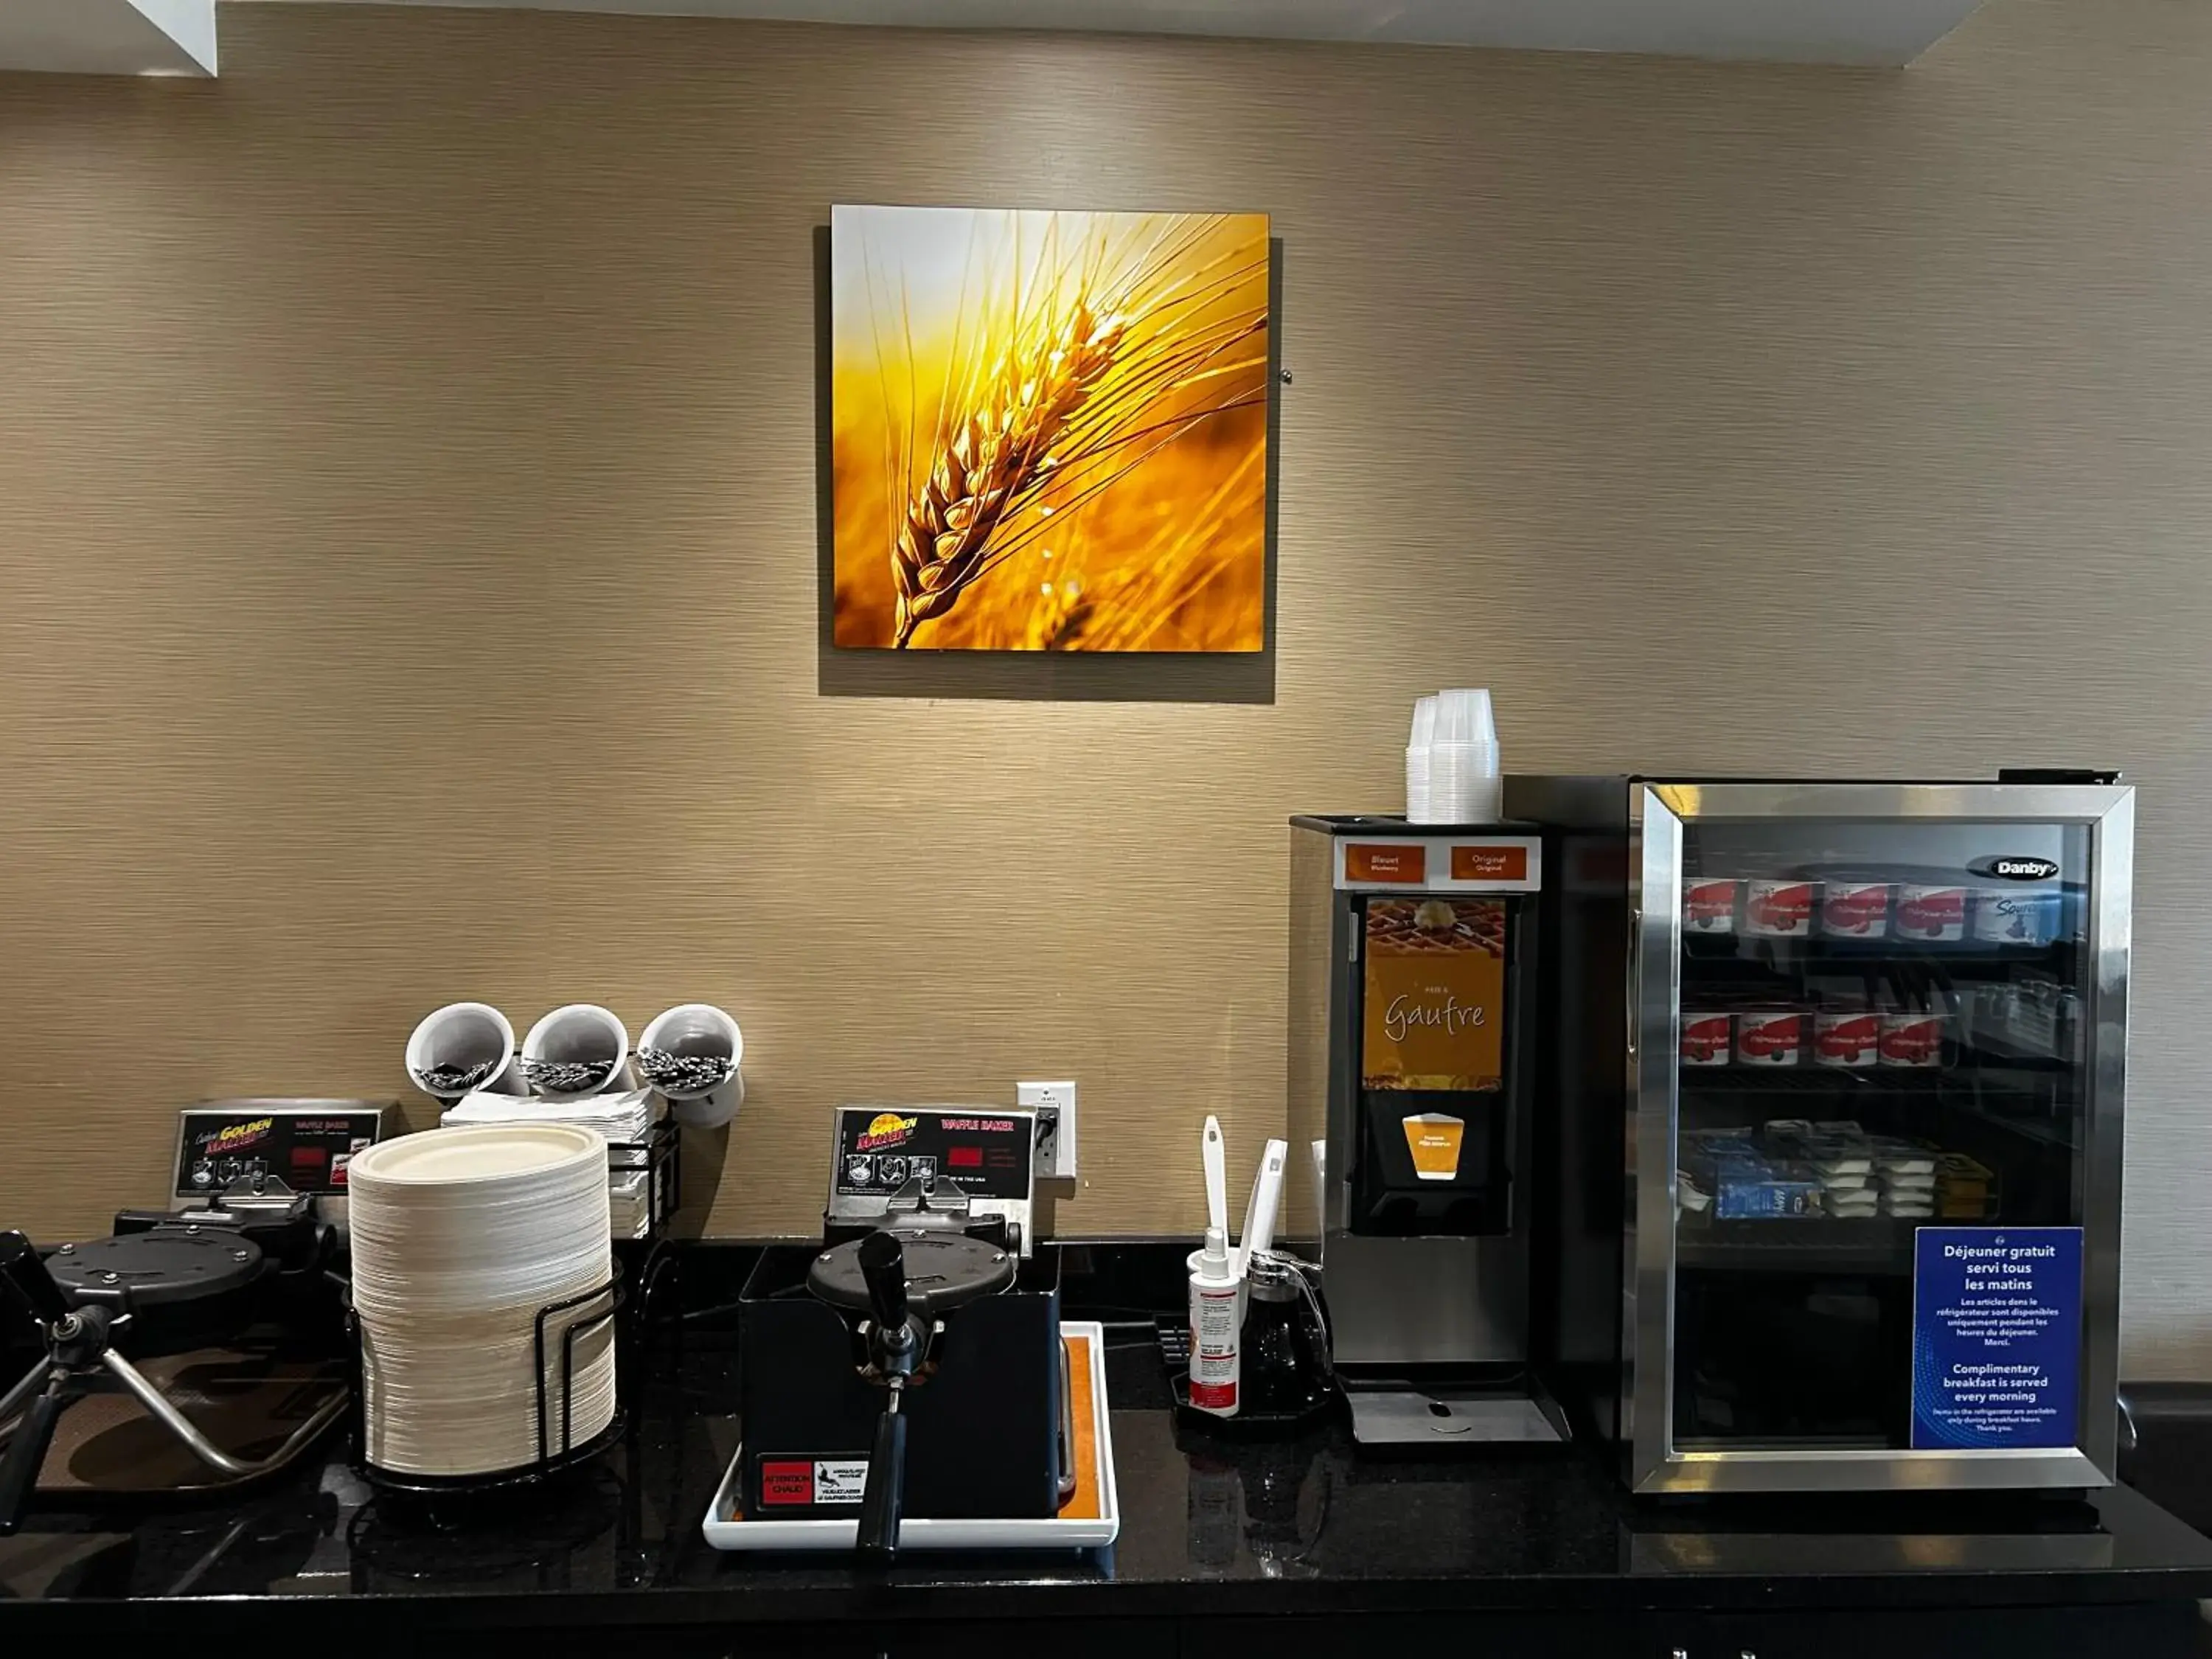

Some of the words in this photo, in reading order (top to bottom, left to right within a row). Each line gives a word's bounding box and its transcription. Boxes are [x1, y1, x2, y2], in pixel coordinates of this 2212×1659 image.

[1472, 855, 1506, 866] Original
[1997, 861, 2048, 877] Danby
[1385, 995, 1485, 1041] Gaufre
[220, 1118, 274, 1140] GOLDEN
[940, 1119, 979, 1130] WAFFLE
[981, 1120, 1014, 1132] BAKER
[1944, 1245, 2008, 1259] Déjeuner
[2010, 1245, 2056, 1260] gratuit
[1966, 1263, 1999, 1273] servi
[2003, 1264, 2031, 1273] tous
[1965, 1279, 1984, 1290] les
[1988, 1279, 2033, 1290] matins
[1937, 1307, 1989, 1317] réfrigérateur
[2011, 1308, 2059, 1317] disponibles
[1947, 1318, 1997, 1327] uniquement
[1999, 1318, 2034, 1327] pendant
[1999, 1329, 2038, 1338] déjeuner.
[1984, 1338, 2011, 1346] Merci.
[1953, 1364, 2039, 1376] Complimentary
[1944, 1377, 1997, 1388] breakfast
[1999, 1377, 2008, 1387] is
[2010, 1377, 2048, 1387] served
[1955, 1393, 1986, 1403] every
[1989, 1391, 2036, 1403] morning
[1964, 1416, 1987, 1425] during
[773, 1485, 803, 1493] CHAUD
